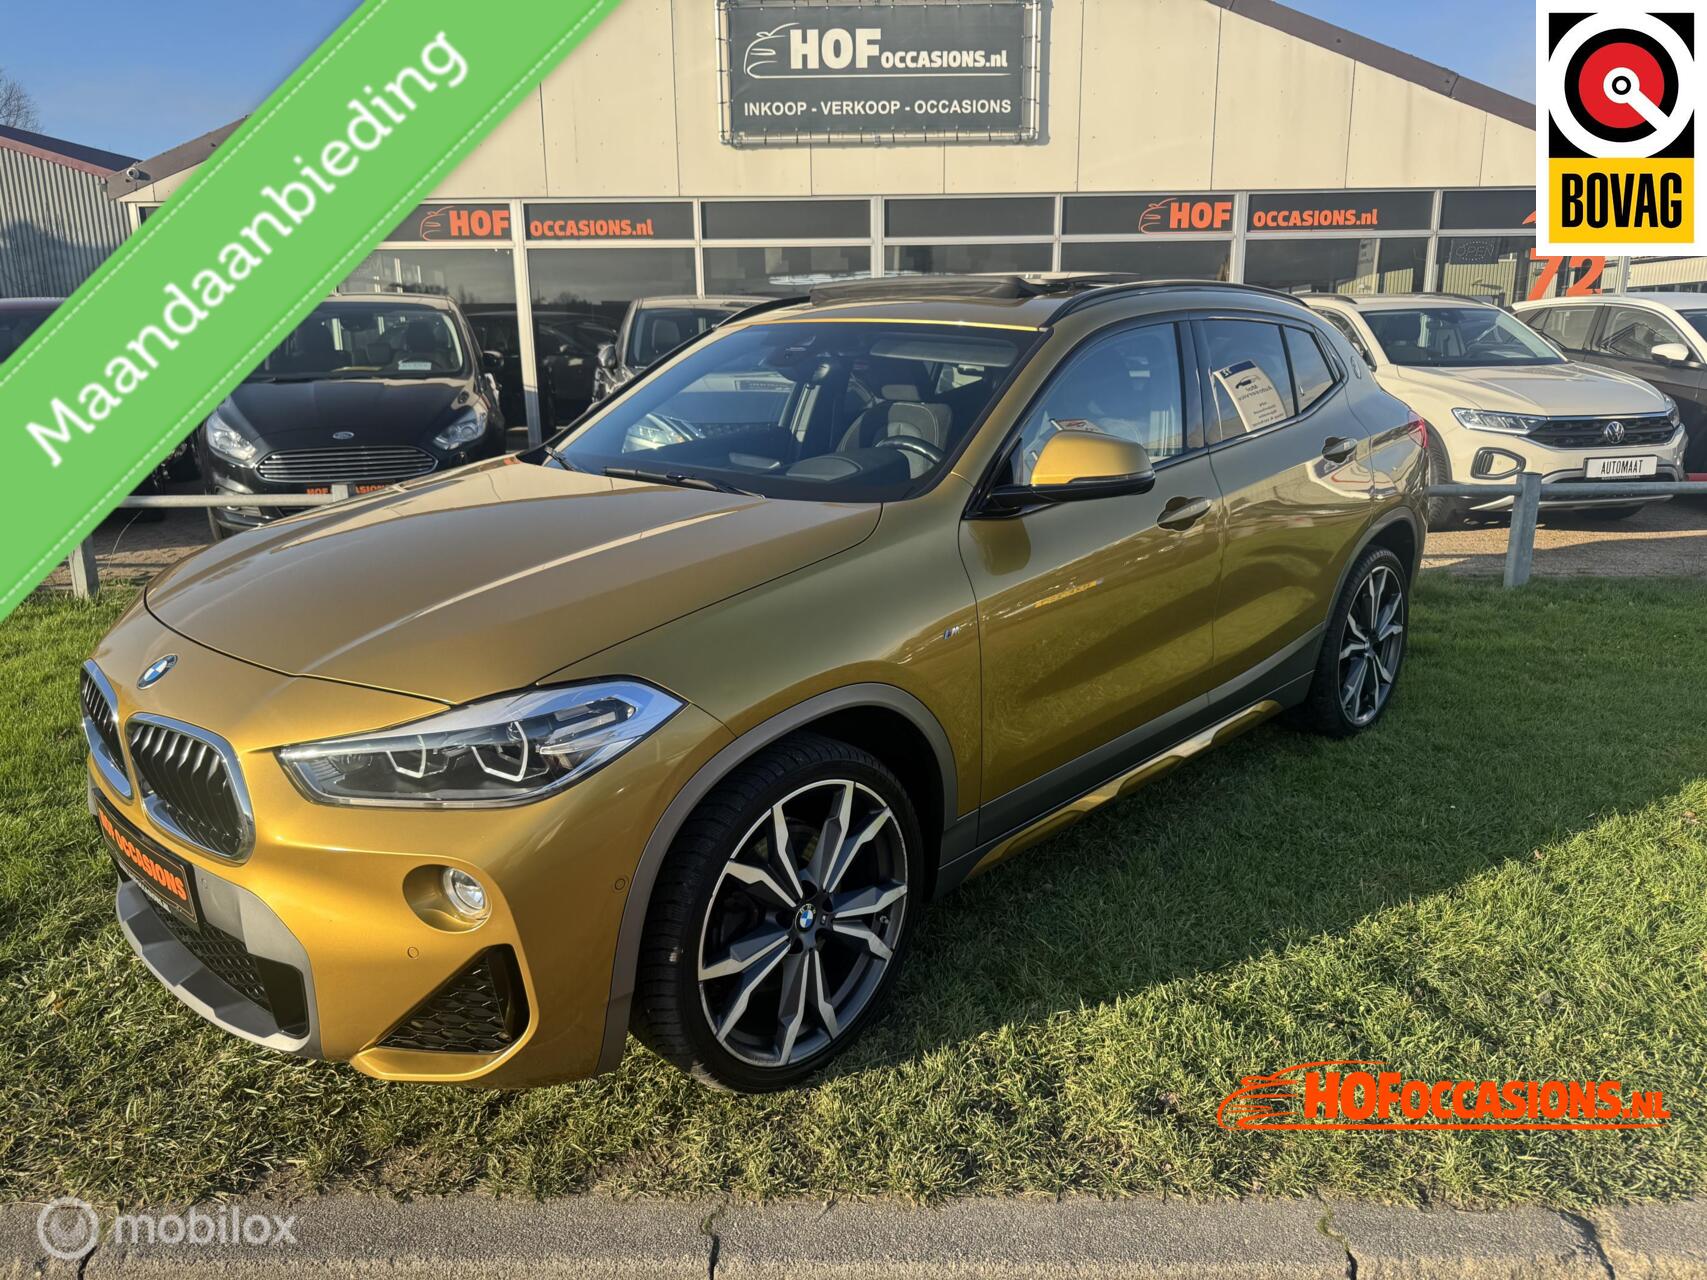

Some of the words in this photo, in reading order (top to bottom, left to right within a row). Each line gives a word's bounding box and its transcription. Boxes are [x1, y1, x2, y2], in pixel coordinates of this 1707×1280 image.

[744, 101, 807, 117] INKOOP
[821, 101, 900, 116] VERKOOP
[914, 99, 1012, 115] OCCASIONS
[450, 210, 511, 236] HOF
[530, 219, 654, 237] OCCASIONS.nl
[1170, 202, 1232, 229] HOF
[1253, 209, 1378, 227] OCCASIONS.nl
[1455, 241, 1496, 257] OPEN
[1528, 247, 1605, 299] 72
[1601, 459, 1643, 475] AUTOMAAT
[115, 828, 188, 902] OCCASIONS
